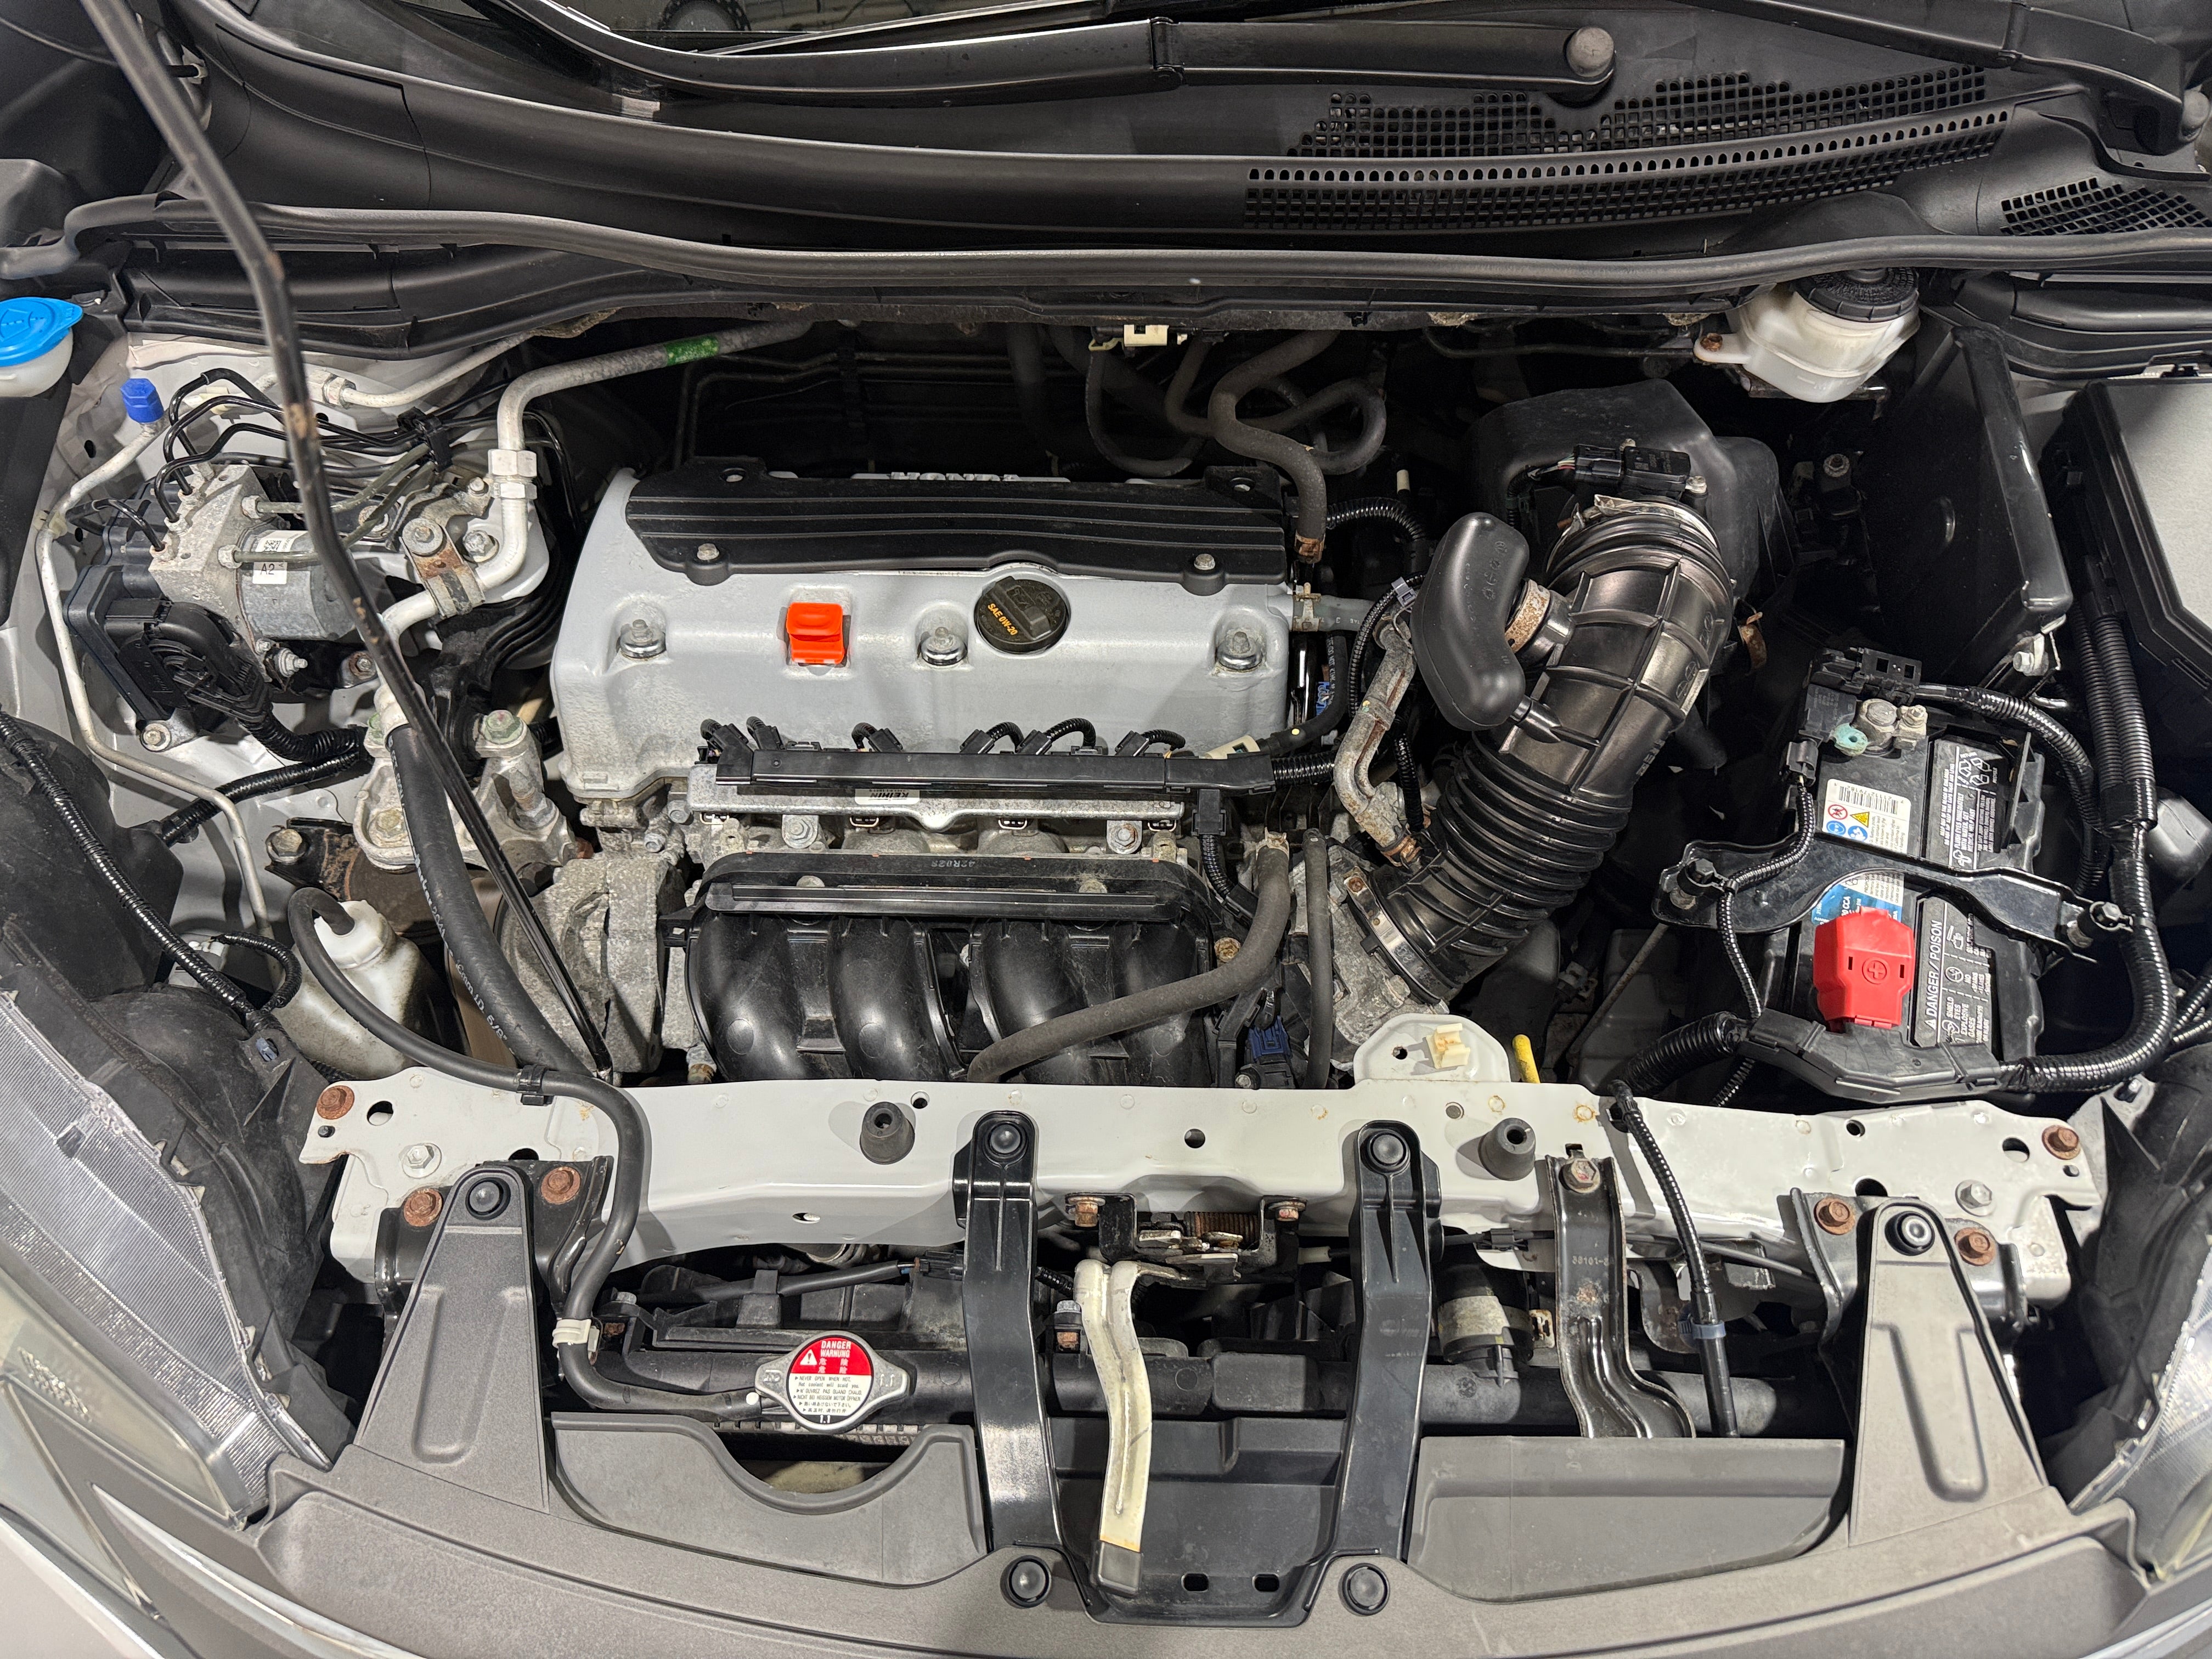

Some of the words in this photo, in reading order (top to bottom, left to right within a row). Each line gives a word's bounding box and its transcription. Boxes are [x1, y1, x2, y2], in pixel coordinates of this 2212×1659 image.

[260, 563, 274, 575] A2
[987, 602, 1003, 618] SAE
[998, 617, 1018, 636] 0W-20
[1842, 895, 1850, 909] CCA
[1929, 919, 1942, 960] POISON
[1965, 974, 1971, 983] NO
[1926, 970, 1938, 1017] DANGER
[1960, 1003, 1968, 1035] EXPLOSIVE
[821, 1340, 851, 1350] DANGER
[820, 1349, 850, 1358] WARNUNG
[879, 1373, 895, 1388] 1.1
[819, 1414, 831, 1424] 1.1
